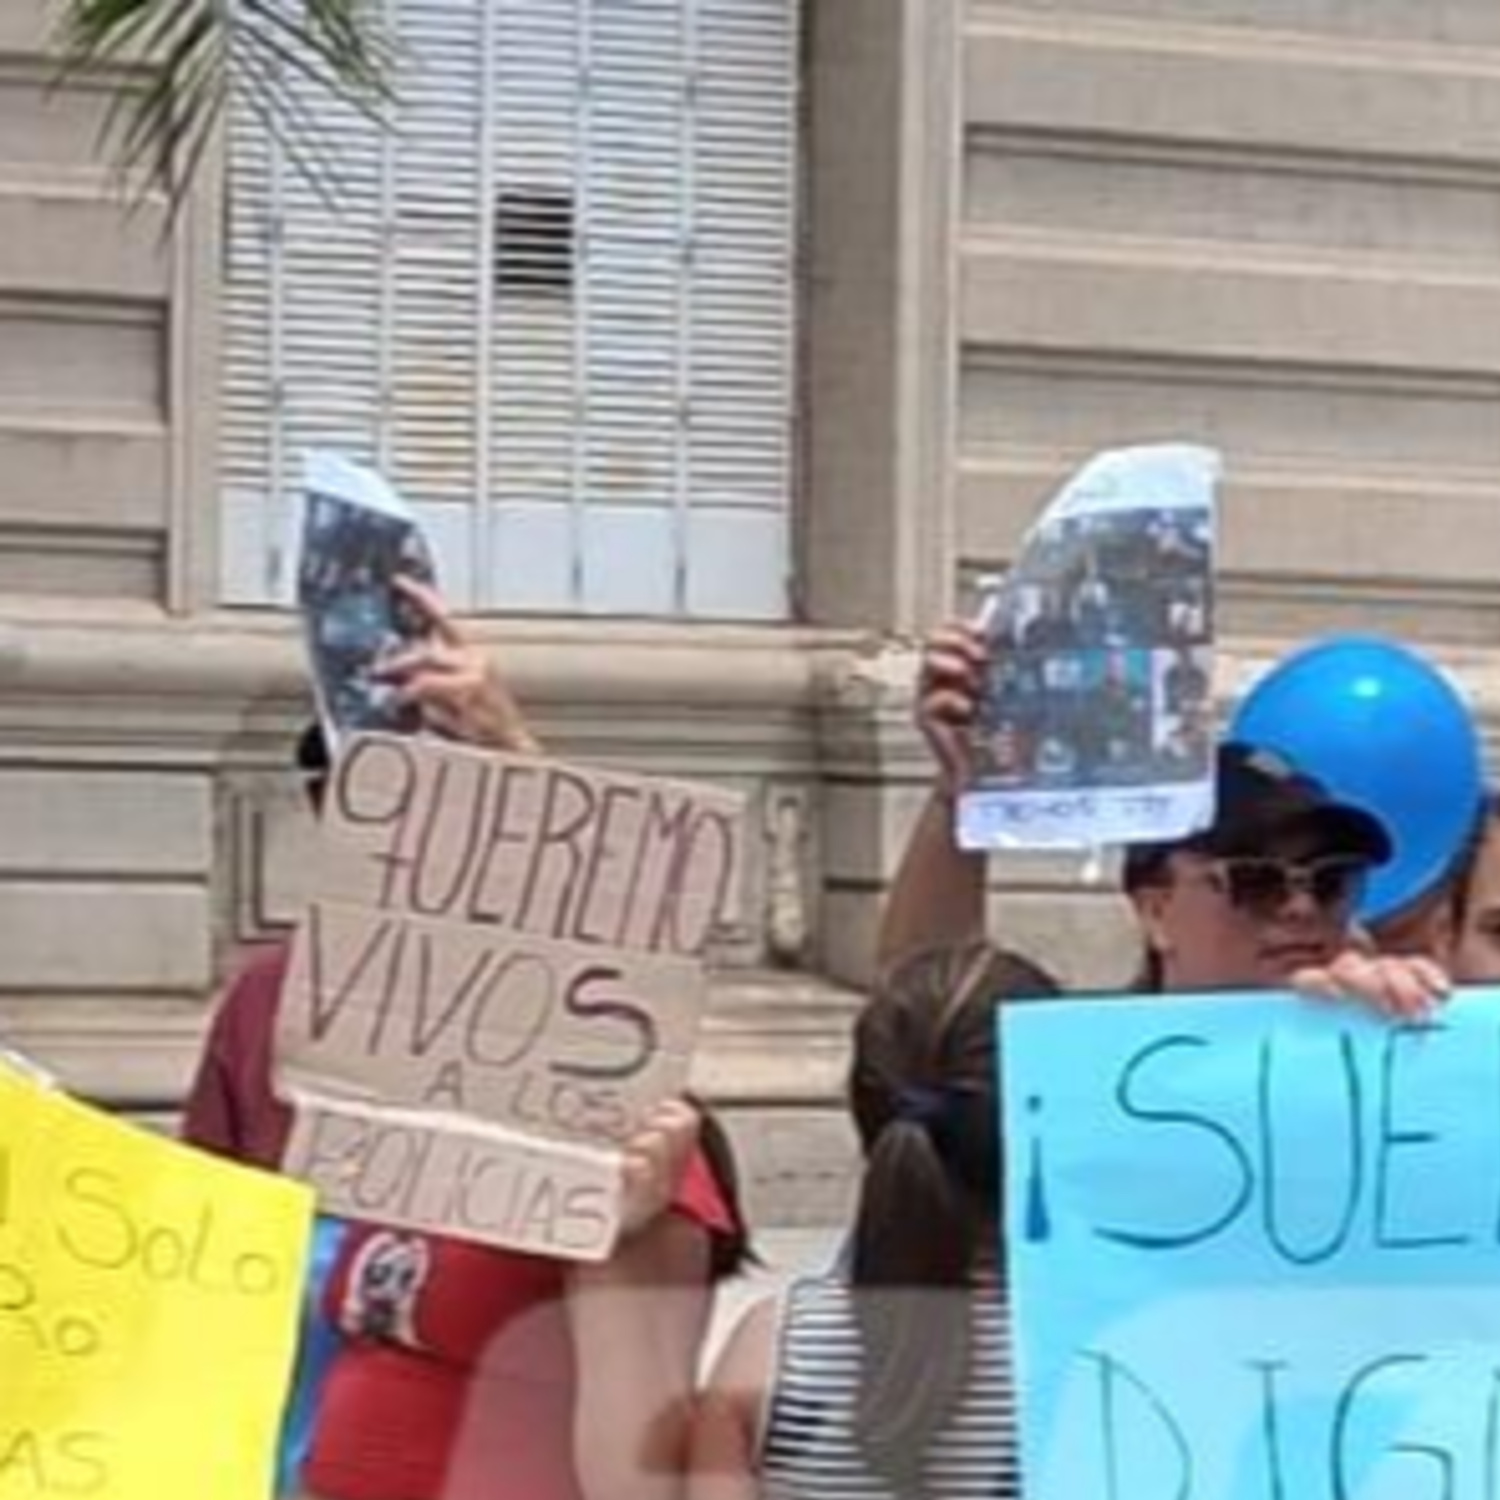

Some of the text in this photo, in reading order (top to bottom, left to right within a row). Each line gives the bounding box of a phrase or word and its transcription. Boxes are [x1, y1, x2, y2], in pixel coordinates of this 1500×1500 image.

[309, 904, 658, 1079] VIVOS
[423, 1060, 627, 1135] A LOS
